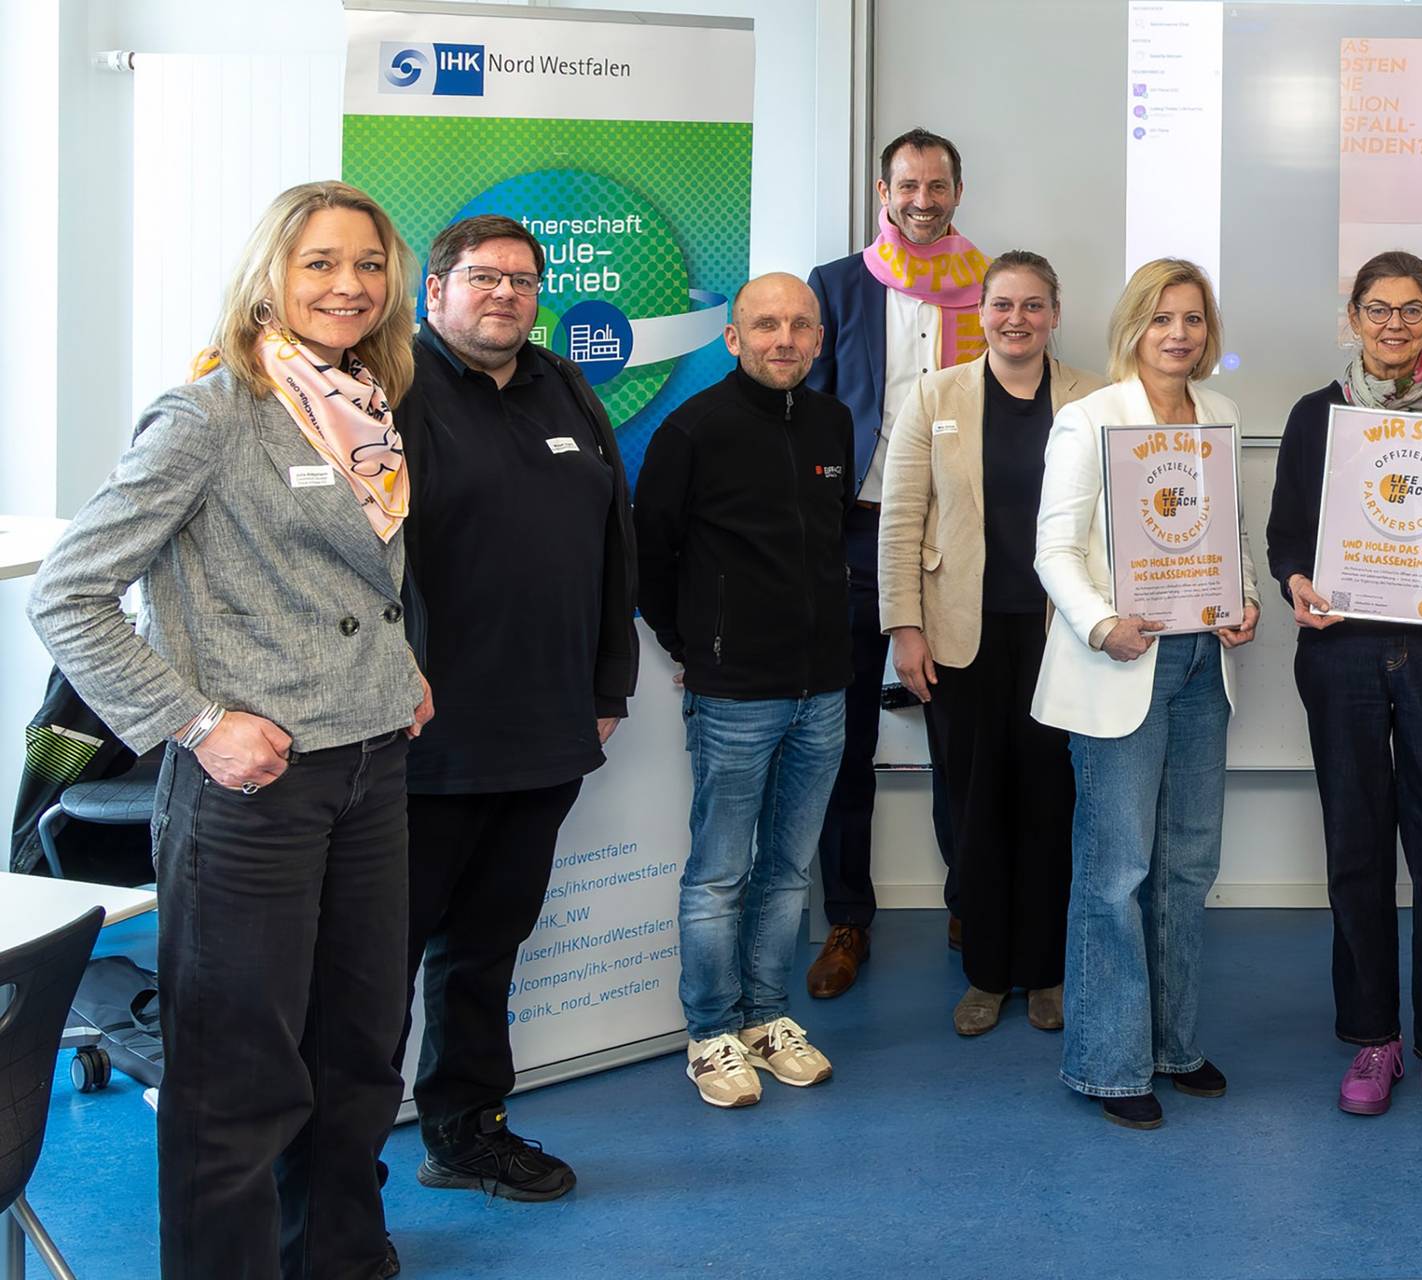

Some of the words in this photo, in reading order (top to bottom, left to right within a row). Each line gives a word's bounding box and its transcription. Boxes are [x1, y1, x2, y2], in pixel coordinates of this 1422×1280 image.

[1344, 40, 1368, 53] AS
[440, 51, 480, 72] IHK
[489, 54, 534, 74] Nord
[540, 56, 631, 78] Westfalen
[1343, 116, 1416, 133] SFALL-
[521, 215, 642, 235] tnerschaft
[538, 266, 620, 293] trieb
[1147, 462, 1199, 484] OFFIZIELLE
[1391, 474, 1419, 485] LIFE
[1162, 487, 1184, 497] LIFE
[1389, 494, 1405, 504] US
[1163, 497, 1197, 507] TEACH
[1140, 496, 1210, 543] PARTNERSCHULE
[1163, 508, 1177, 517] US
[1343, 540, 1362, 549] UND
[1365, 541, 1396, 552] HOLEN
[1399, 544, 1419, 555] DAS
[1178, 555, 1195, 565] DAS
[552, 842, 638, 869] ordwestfalen
[519, 945, 681, 994] /company/ihk-nord-west
[519, 977, 660, 1023] @ihk_nord_westfalen
